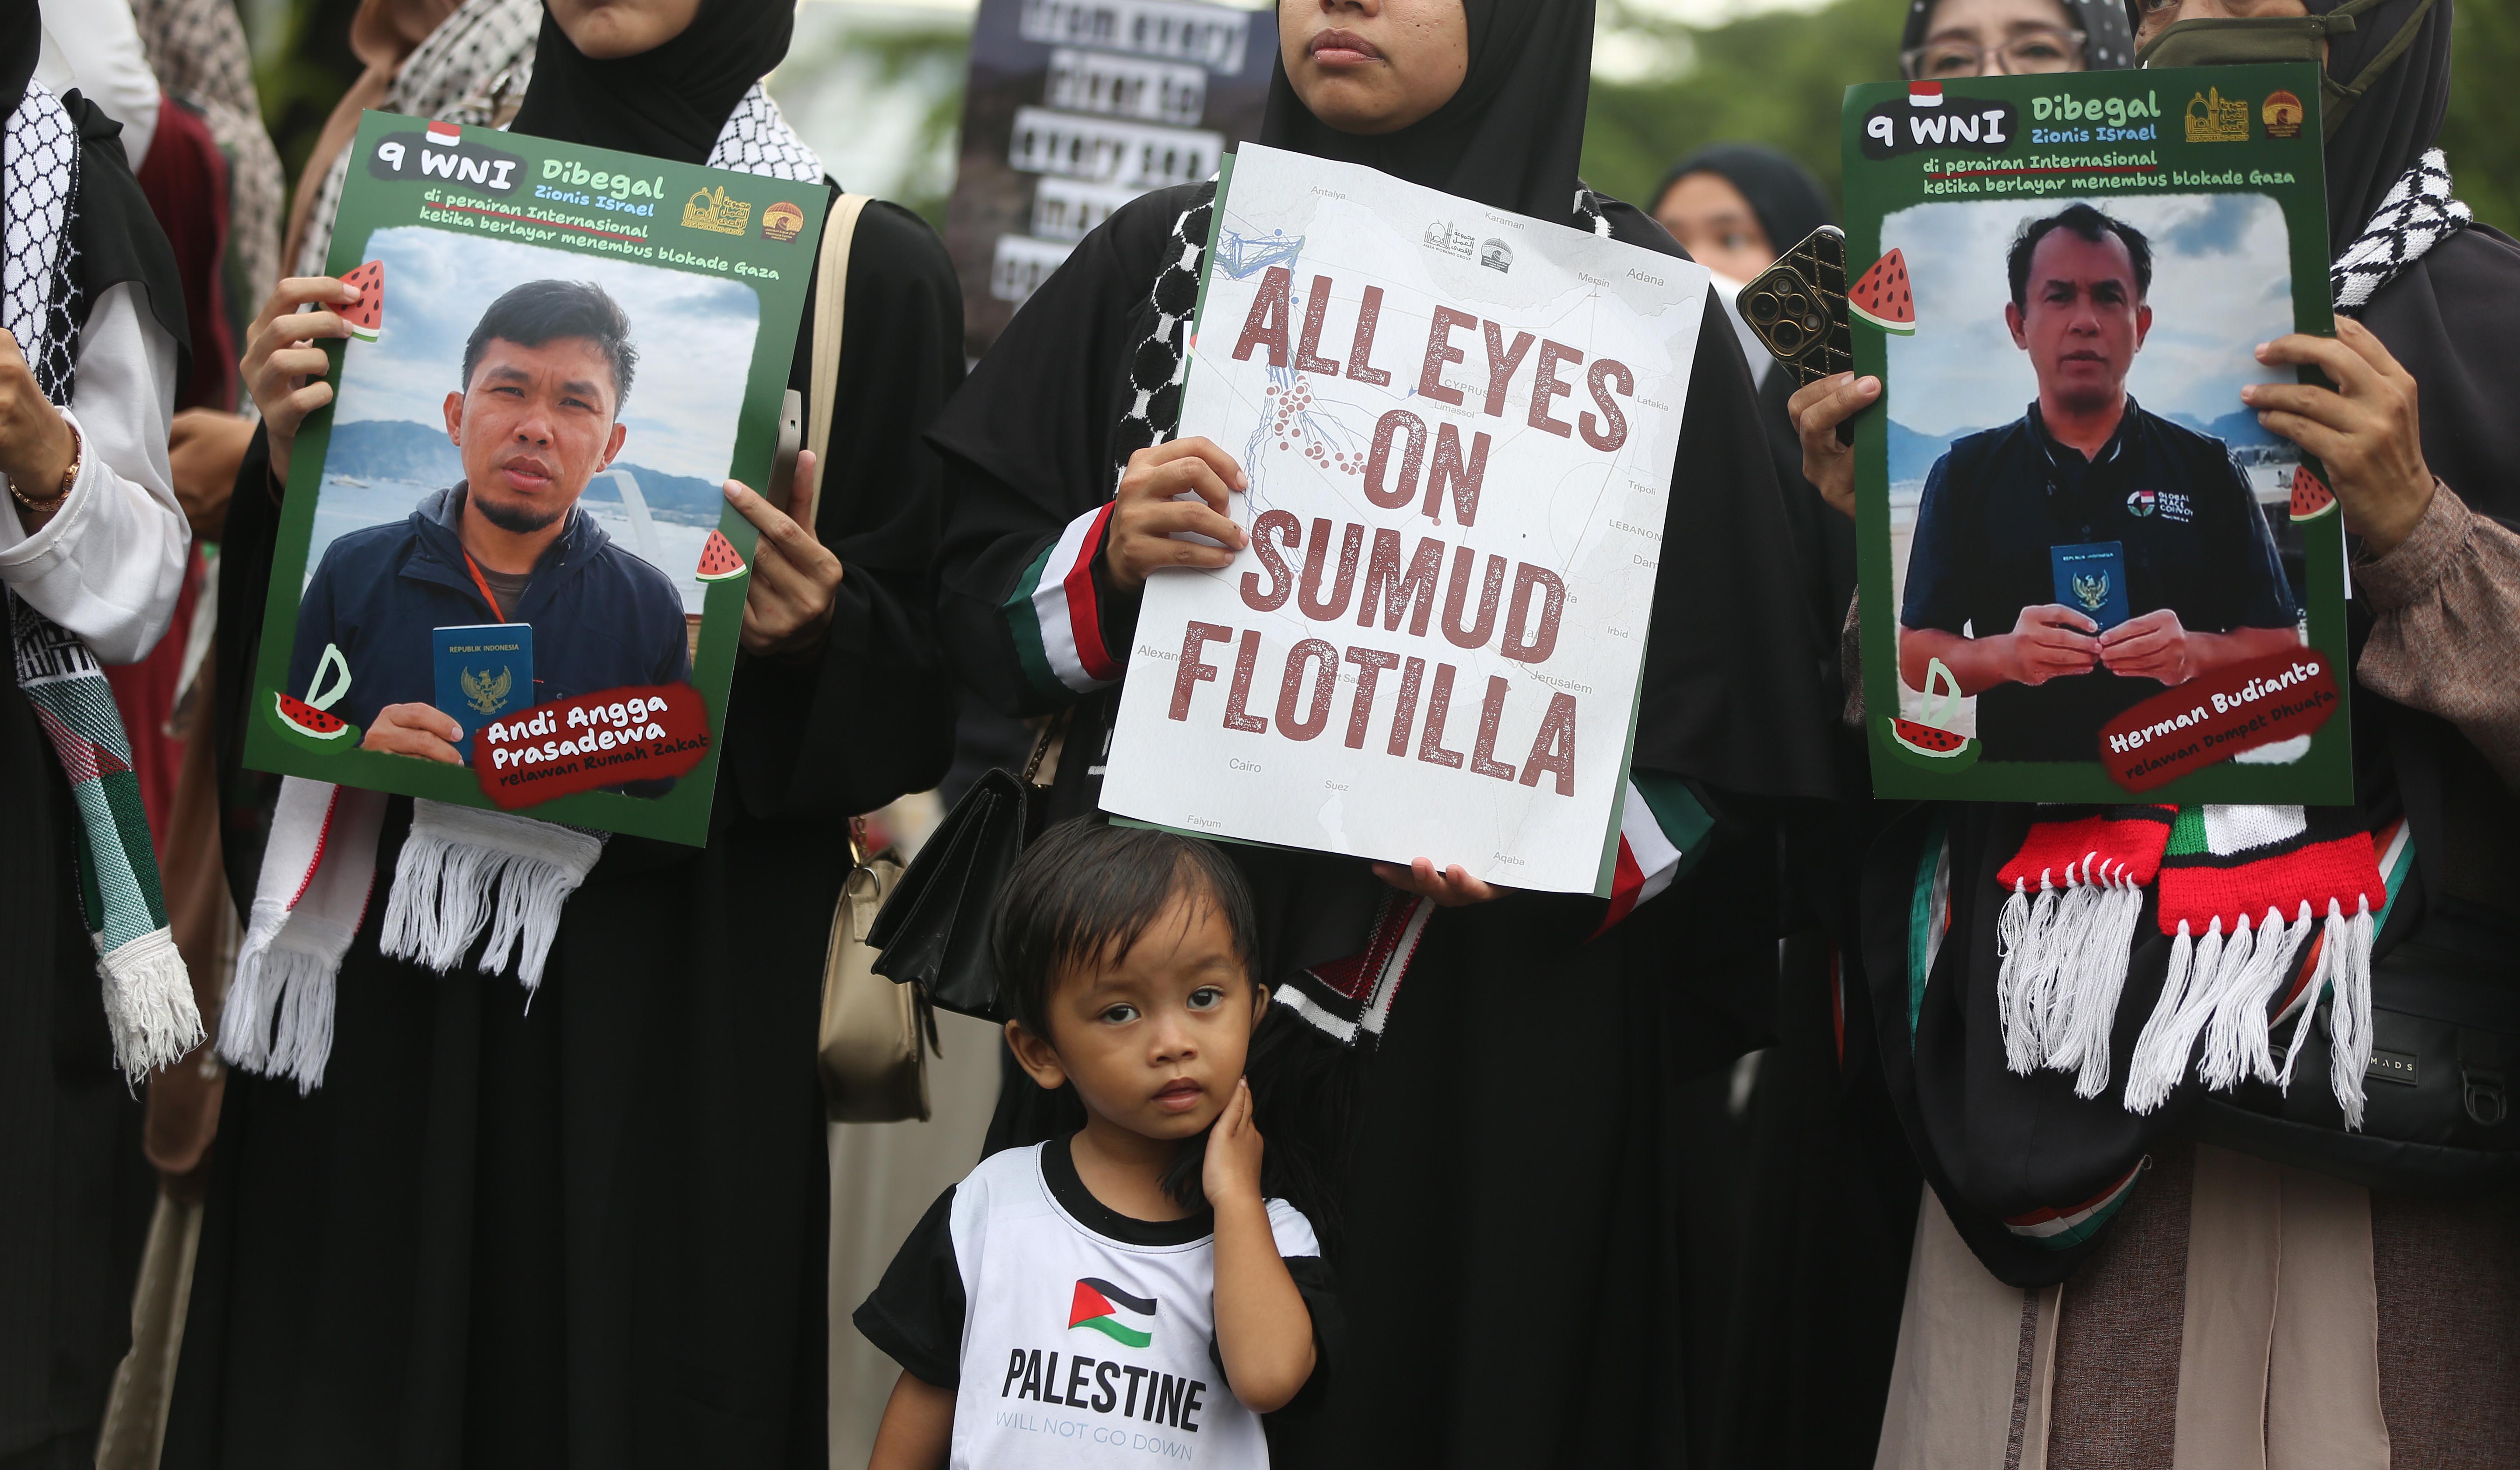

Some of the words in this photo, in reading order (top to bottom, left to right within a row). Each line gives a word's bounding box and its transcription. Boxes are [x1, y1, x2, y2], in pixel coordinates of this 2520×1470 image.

[2032, 90, 2161, 127] Dibegal
[1866, 116, 1895, 148] 9
[1909, 109, 2007, 144] WNI
[2032, 127, 2090, 144] Zionis
[2095, 124, 2157, 142] Israel
[378, 141, 405, 171] 9
[420, 149, 516, 190] WNI
[1923, 158, 1939, 173] di
[1946, 156, 2025, 177] perairan
[2029, 150, 2158, 170] Internasional
[542, 160, 665, 200] Dibegal
[1310, 186, 1346, 200] Antalya
[1923, 178, 1981, 195] ketika
[1985, 175, 2067, 196] berlayar
[2072, 172, 2167, 189] menembus
[2173, 170, 2244, 186] blokade
[2249, 169, 2296, 186] Gaza
[424, 188, 440, 204] di
[445, 192, 522, 218] perairan
[526, 206, 648, 239] Internasional
[535, 185, 590, 205] Zionis
[595, 196, 654, 217] Israel
[1485, 211, 1525, 231] Karaman
[419, 206, 475, 228] ketika
[480, 216, 557, 242] berlayar
[561, 231, 653, 259] menembus
[658, 247, 728, 272] blokade
[733, 261, 780, 281] Gaza
[1435, 246, 1456, 256] WORKING
[1456, 253, 1471, 261] GROUP
[1578, 272, 1610, 287] Mersin
[1627, 268, 1664, 286] Adana
[1232, 266, 1391, 387] ALL
[1418, 304, 1634, 452] EYES
[1445, 379, 1488, 398] CYPRUS
[1435, 401, 1475, 418] Limassol
[1637, 395, 1669, 412] Latakia
[1363, 410, 1491, 527] ON
[1628, 480, 1656, 496] Tripoli
[1609, 519, 1662, 542] LEBANON
[1240, 510, 1565, 664] SUMUD
[1607, 626, 1628, 638] Irbid
[1138, 644, 1182, 662] Alexan
[1530, 670, 1592, 695] Jerusalem
[487, 709, 556, 745] Andi
[566, 695, 668, 728] Angga
[1168, 620, 1576, 797] FLOTILLA
[2110, 707, 2209, 754] Herman
[2211, 662, 2320, 714] Budianto
[493, 719, 666, 770] Prasadewa
[2125, 742, 2200, 779] relawan
[2202, 714, 2267, 748] Dompet
[2271, 690, 2334, 722] Dhuafa
[499, 761, 579, 788] relawan
[584, 745, 648, 772] Rumah
[653, 733, 710, 758] Zakat
[1229, 757, 1261, 773] Cairo
[1324, 780, 1349, 791] Suez
[1187, 815, 1222, 828] Faiyum
[1493, 852, 1525, 866] Aqaba
[1001, 1348, 1206, 1433] PALESTINE
[996, 1411, 1038, 1432] WILL
[1043, 1418, 1088, 1439] NOT
[1094, 1427, 1127, 1446] GO
[1133, 1434, 1193, 1461] DOWN
